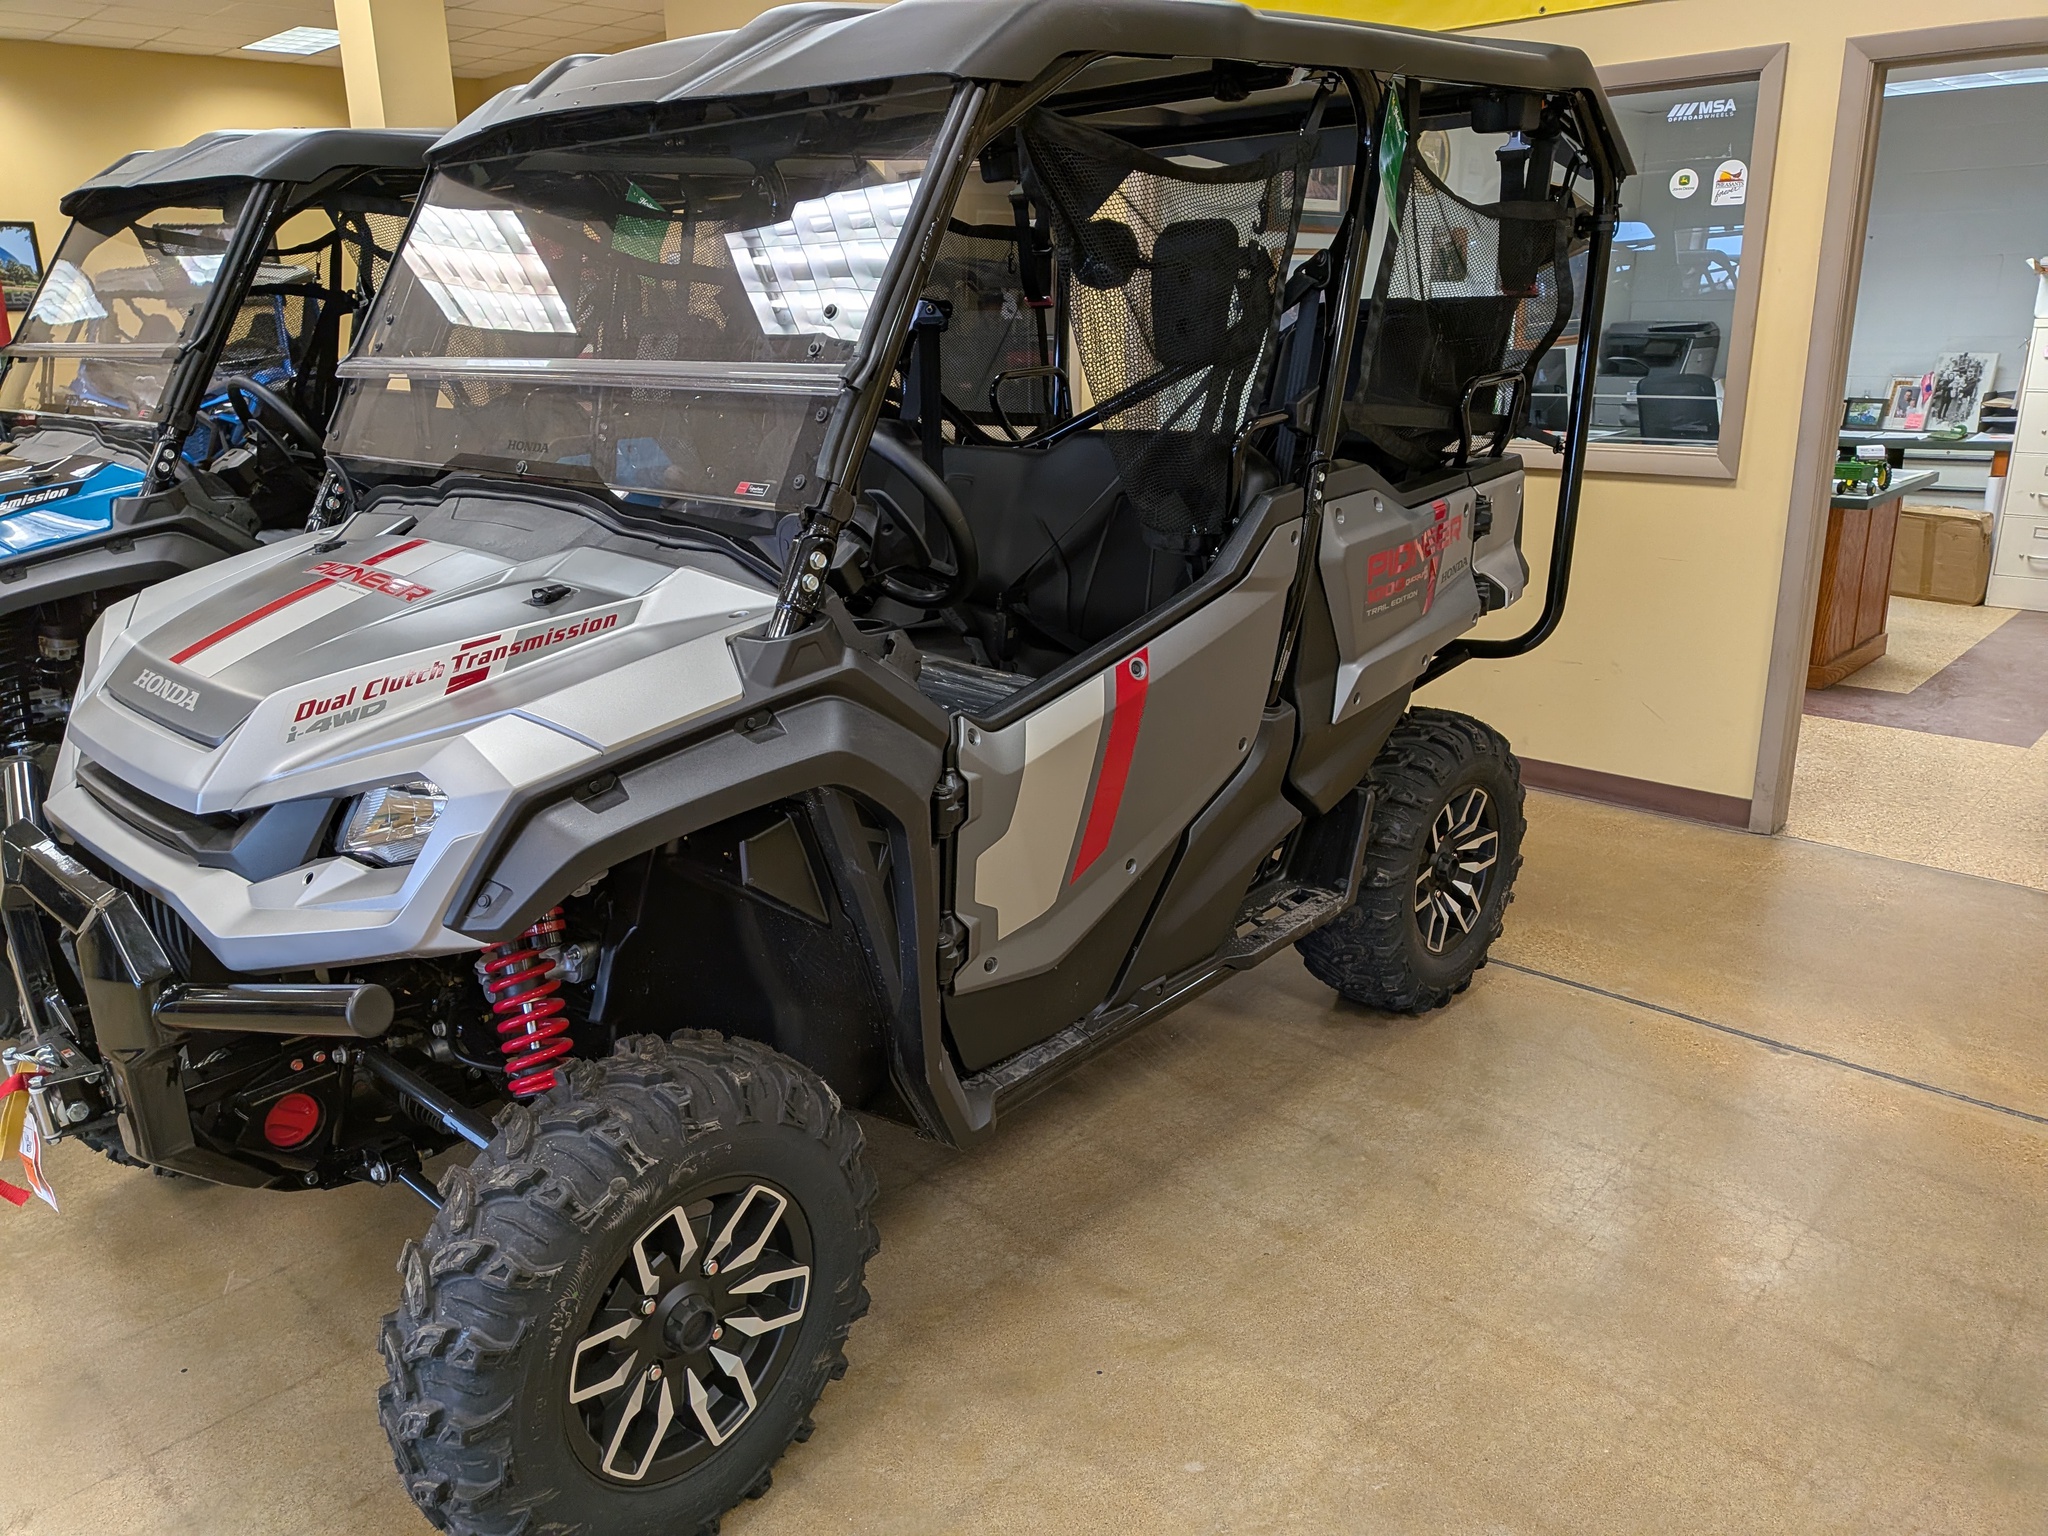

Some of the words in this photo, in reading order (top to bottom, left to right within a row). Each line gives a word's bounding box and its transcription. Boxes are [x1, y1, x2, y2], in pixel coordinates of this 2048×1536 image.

[1699, 99, 1736, 114] MSA
[508, 439, 549, 453] HONDA
[1367, 514, 1463, 586] PIONEER
[1441, 557, 1468, 584] HONDA
[302, 561, 436, 602] PIONEER
[1366, 603, 1389, 617] TRAIL
[1390, 589, 1418, 607] EDITION
[294, 686, 357, 722] Dual
[362, 660, 446, 700] Clutch
[451, 613, 618, 673] Transmission
[133, 668, 200, 712] HONDA
[286, 699, 388, 743] i-4WD
